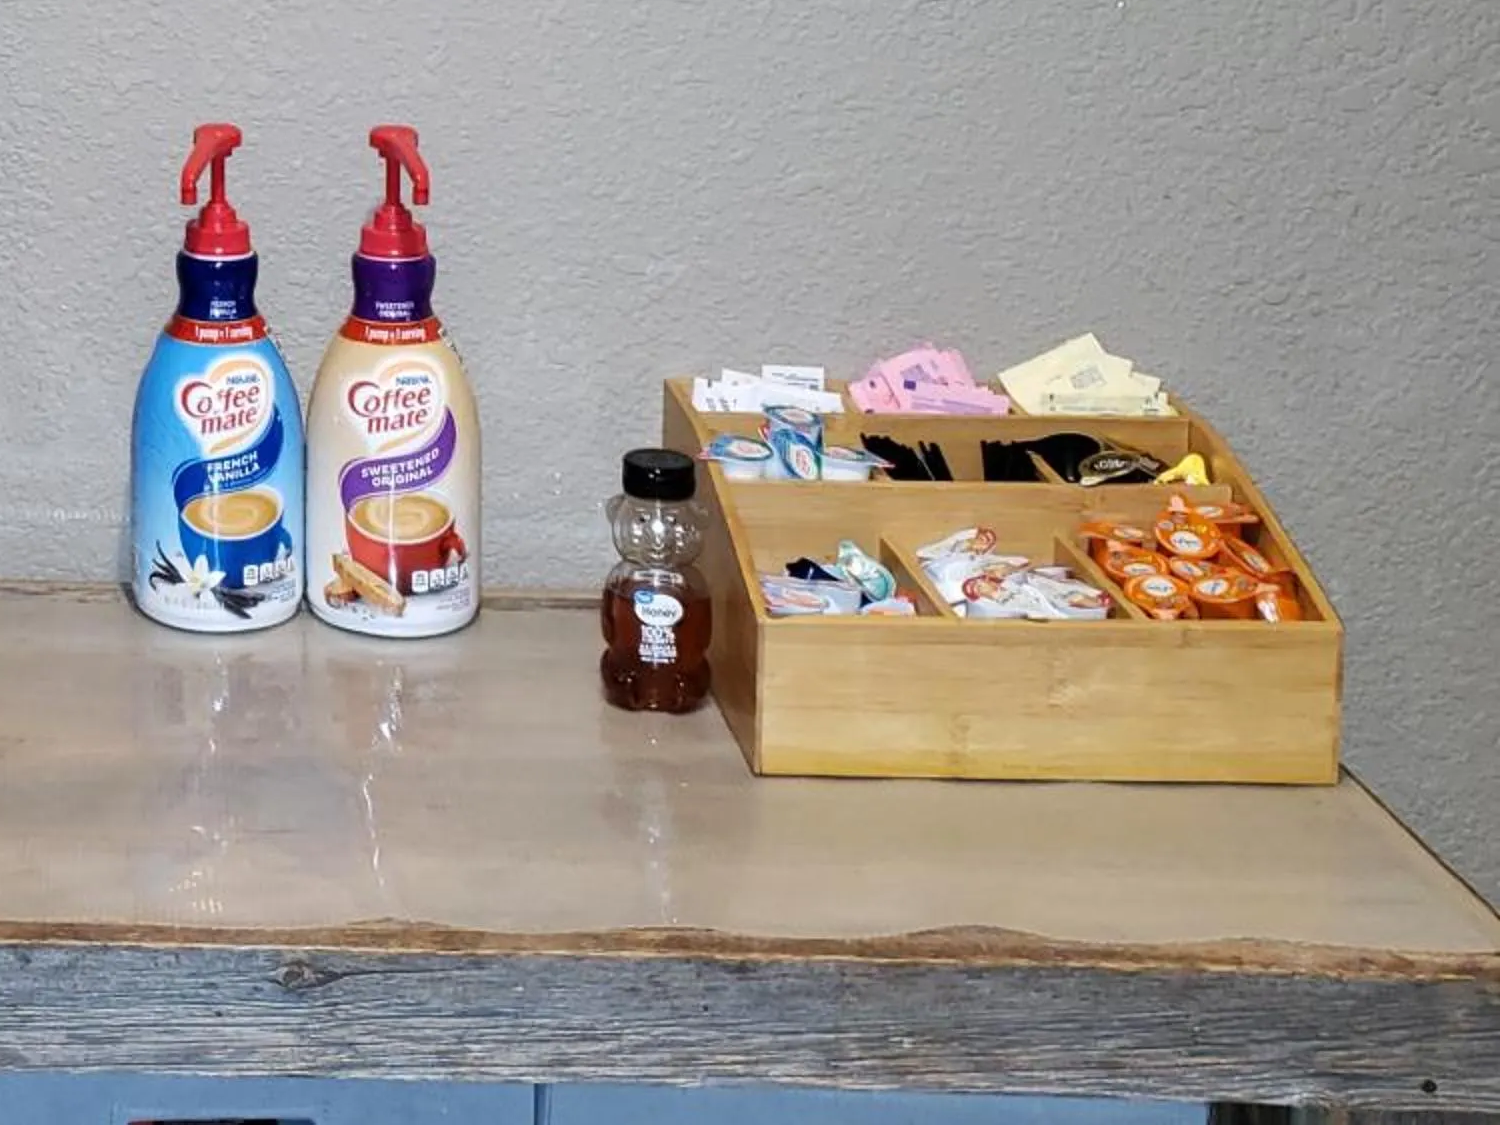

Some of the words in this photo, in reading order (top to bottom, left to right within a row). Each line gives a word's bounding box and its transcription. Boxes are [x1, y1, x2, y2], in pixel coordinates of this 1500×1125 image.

[348, 381, 431, 418] Coffee
[201, 407, 258, 434] mate
[367, 408, 428, 434] mate
[207, 451, 258, 471] FRENCH
[208, 462, 260, 483] VANILLA
[361, 448, 440, 478] SWEETENED
[371, 467, 433, 487] ORIGINAL
